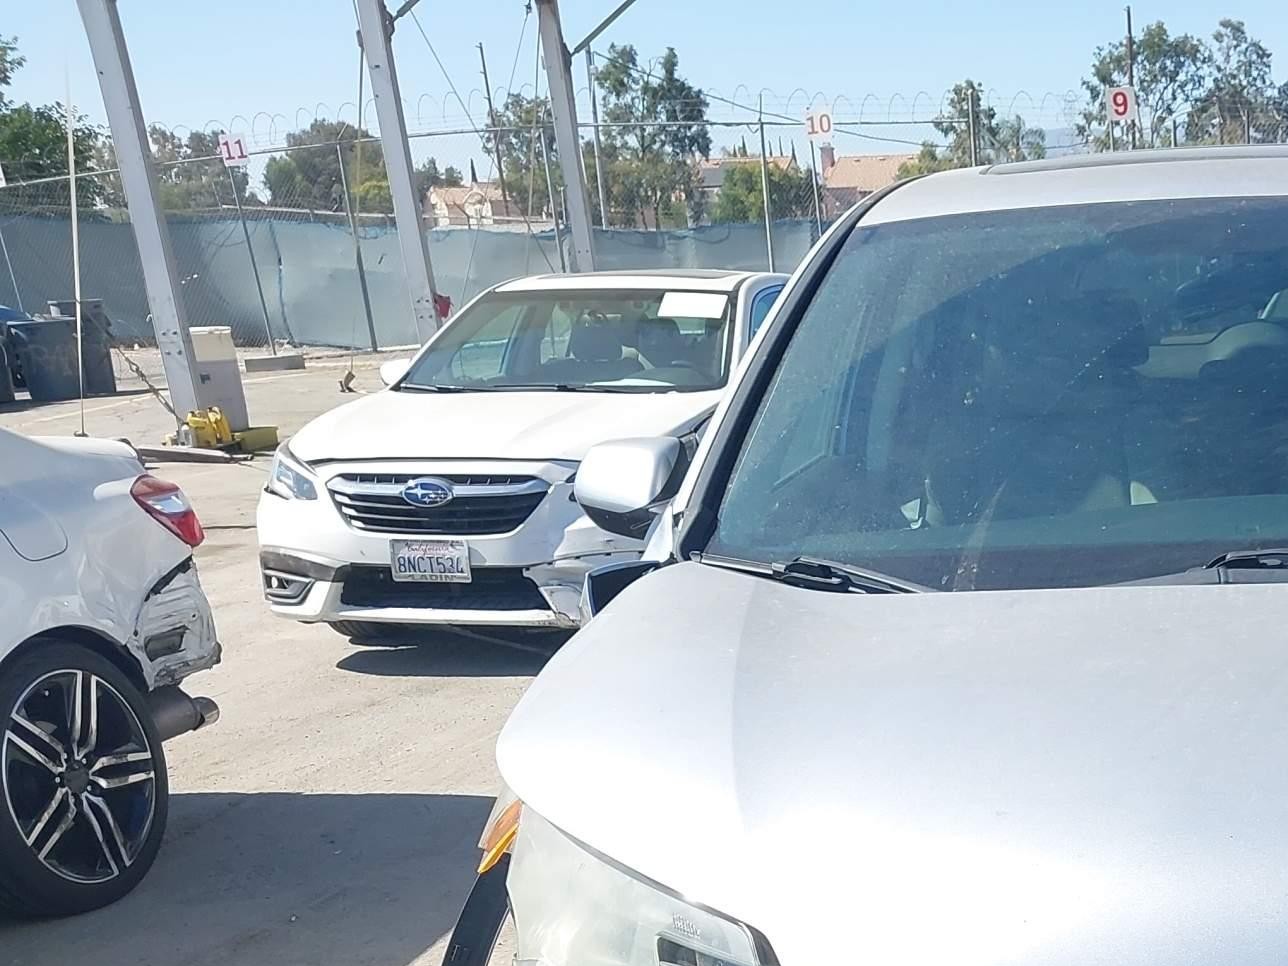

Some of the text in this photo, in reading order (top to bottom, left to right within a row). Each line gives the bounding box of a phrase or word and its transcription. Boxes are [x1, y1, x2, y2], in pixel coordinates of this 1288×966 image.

[1112, 91, 1129, 116] 9
[806, 113, 832, 135] 10
[221, 138, 248, 161] 11
